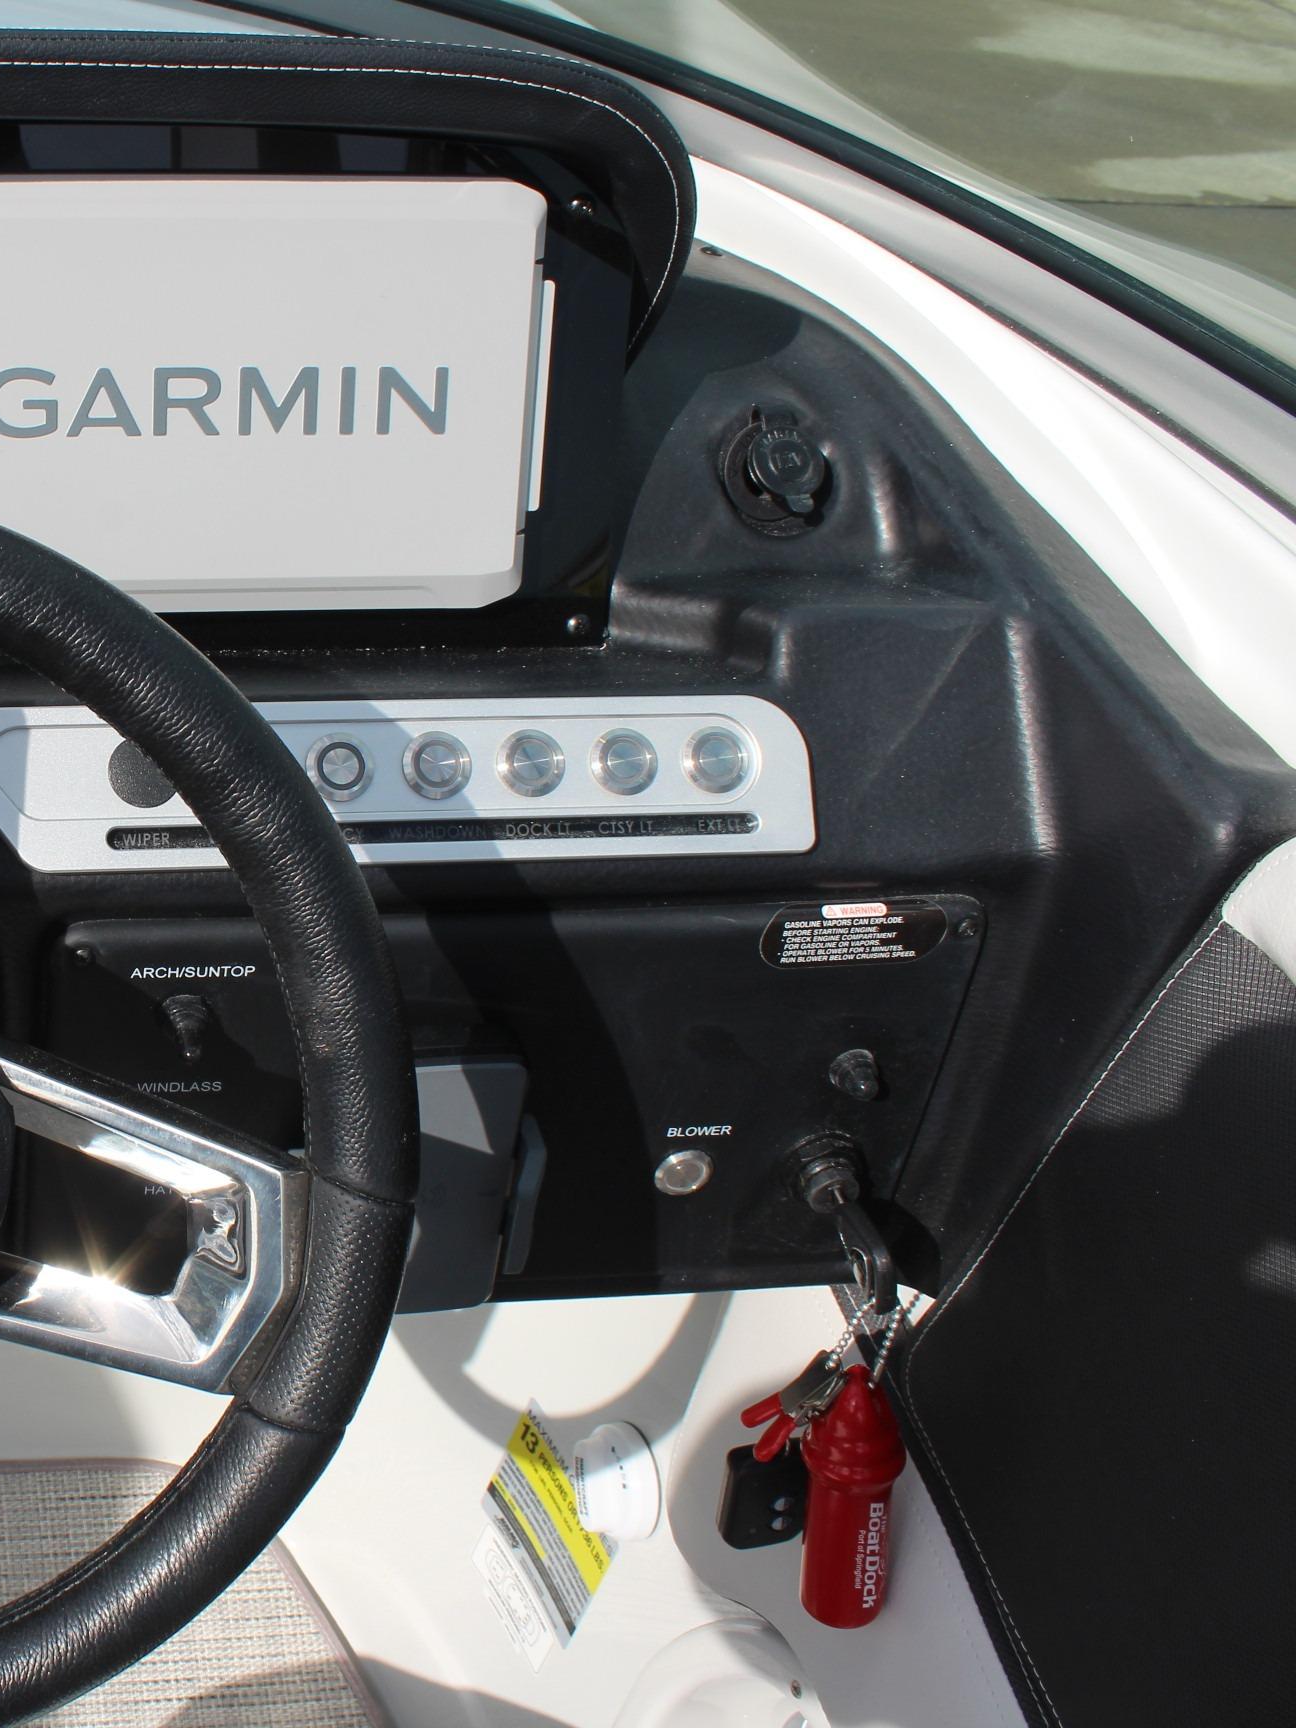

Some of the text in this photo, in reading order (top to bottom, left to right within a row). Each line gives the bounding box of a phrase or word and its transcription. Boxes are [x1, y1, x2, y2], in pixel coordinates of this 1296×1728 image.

[388, 824, 486, 839] WASHDOWN
[506, 821, 571, 837] DOCK LT
[598, 820, 653, 834] CTSY LT
[698, 819, 723, 832] EXT
[123, 832, 170, 846] WIPER
[840, 906, 883, 915] WARNING
[784, 920, 820, 928] GASOLINE
[822, 918, 851, 926] VAPORS
[870, 916, 904, 924] EXPLODE.
[814, 927, 848, 935] STARTING
[842, 932, 897, 940] COMPARTMENT
[856, 951, 890, 959] CRUISING
[130, 965, 256, 979] ARCH/SUNTOP
[137, 1081, 222, 1094] WINDLASS
[666, 1124, 732, 1138] BLOWER
[517, 1420, 542, 1455] 13
[538, 1451, 569, 1502] PERSONS
[867, 1503, 884, 1554] Boat
[854, 1530, 866, 1589] Port of Springfield
[862, 1555, 880, 1608] Dock
